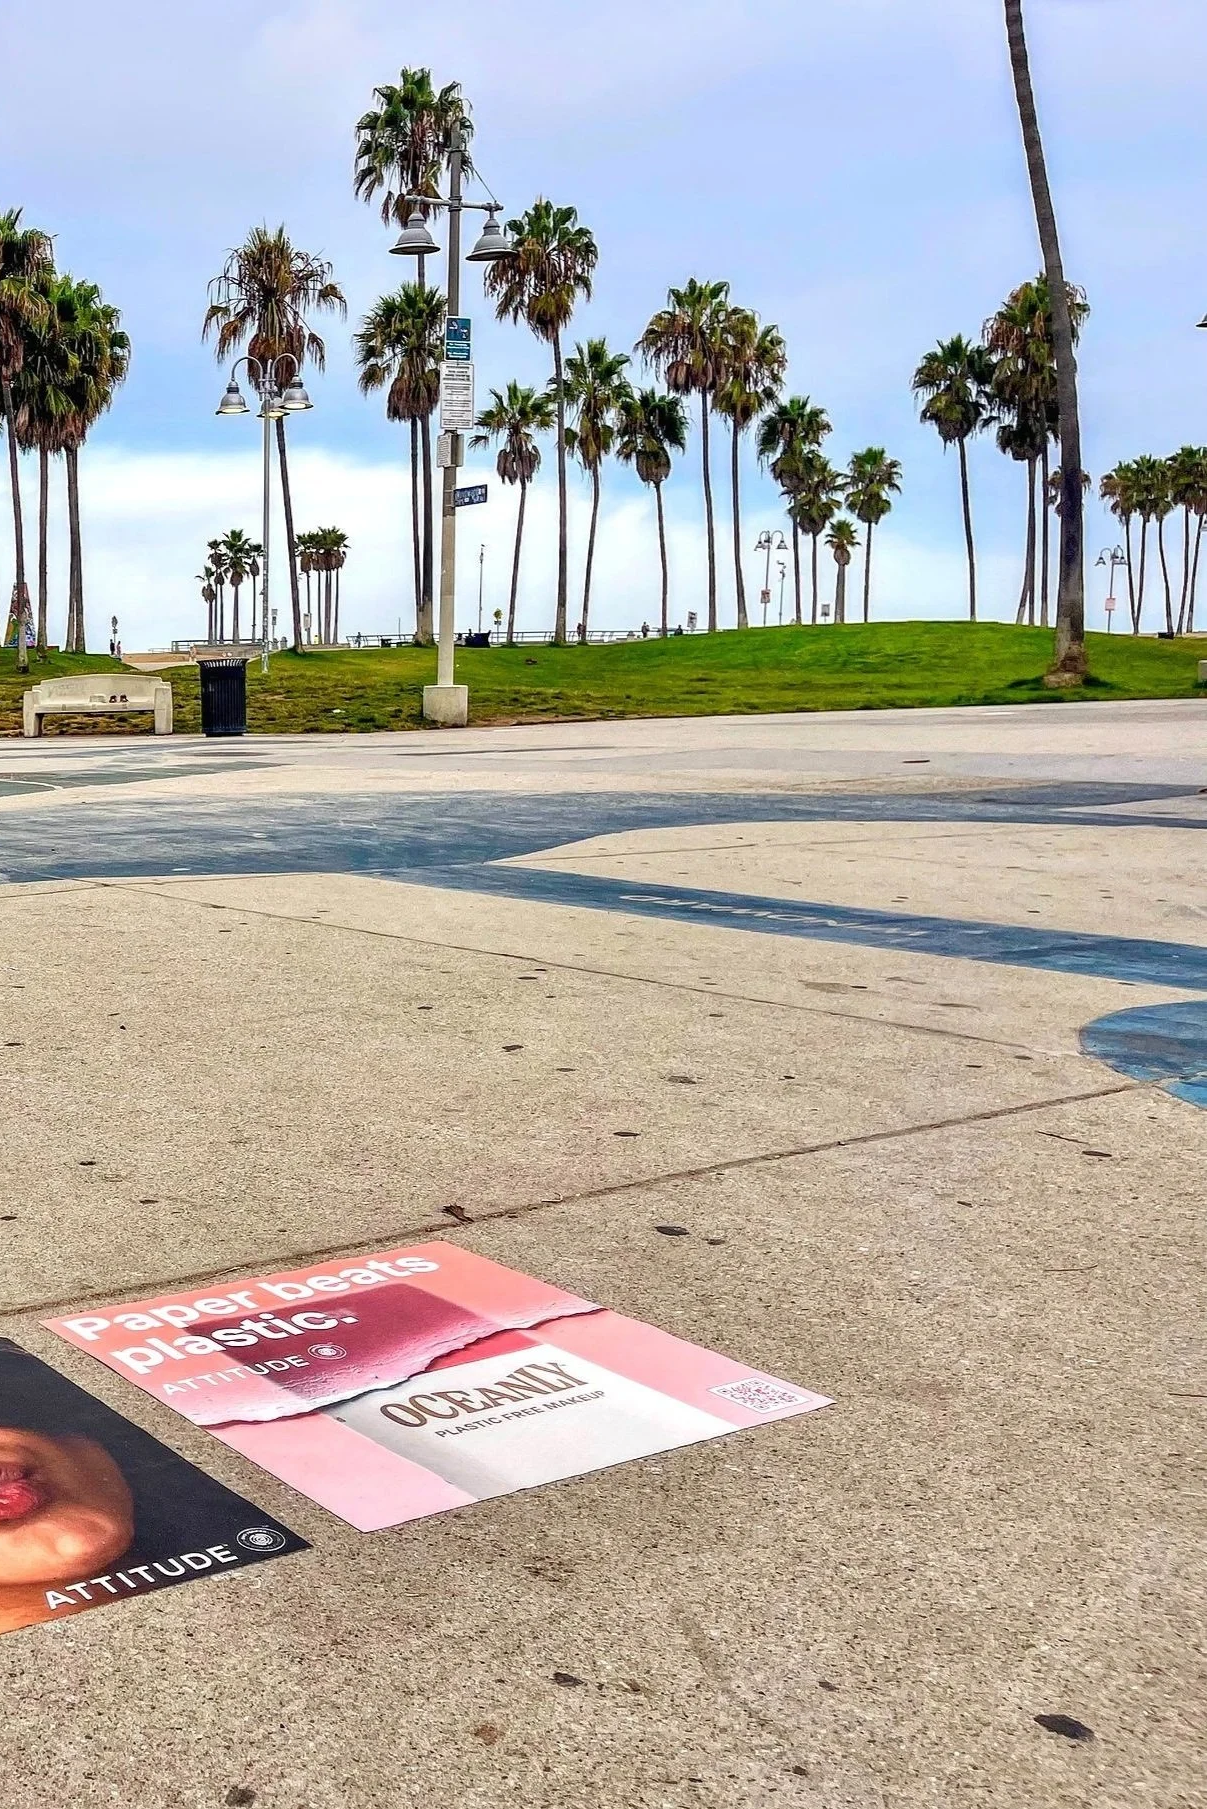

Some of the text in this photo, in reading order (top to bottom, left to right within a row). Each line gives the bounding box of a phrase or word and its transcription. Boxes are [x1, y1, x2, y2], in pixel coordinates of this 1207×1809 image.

[63, 1256, 439, 1341] Paper beats
[110, 1310, 359, 1374] plastic.
[161, 1354, 308, 1396] ATTITUDE
[381, 1362, 589, 1428] OCEANLY
[435, 1390, 605, 1438] PLASTIC FREE MAKEUP
[45, 1545, 238, 1610] ATTITUDE
